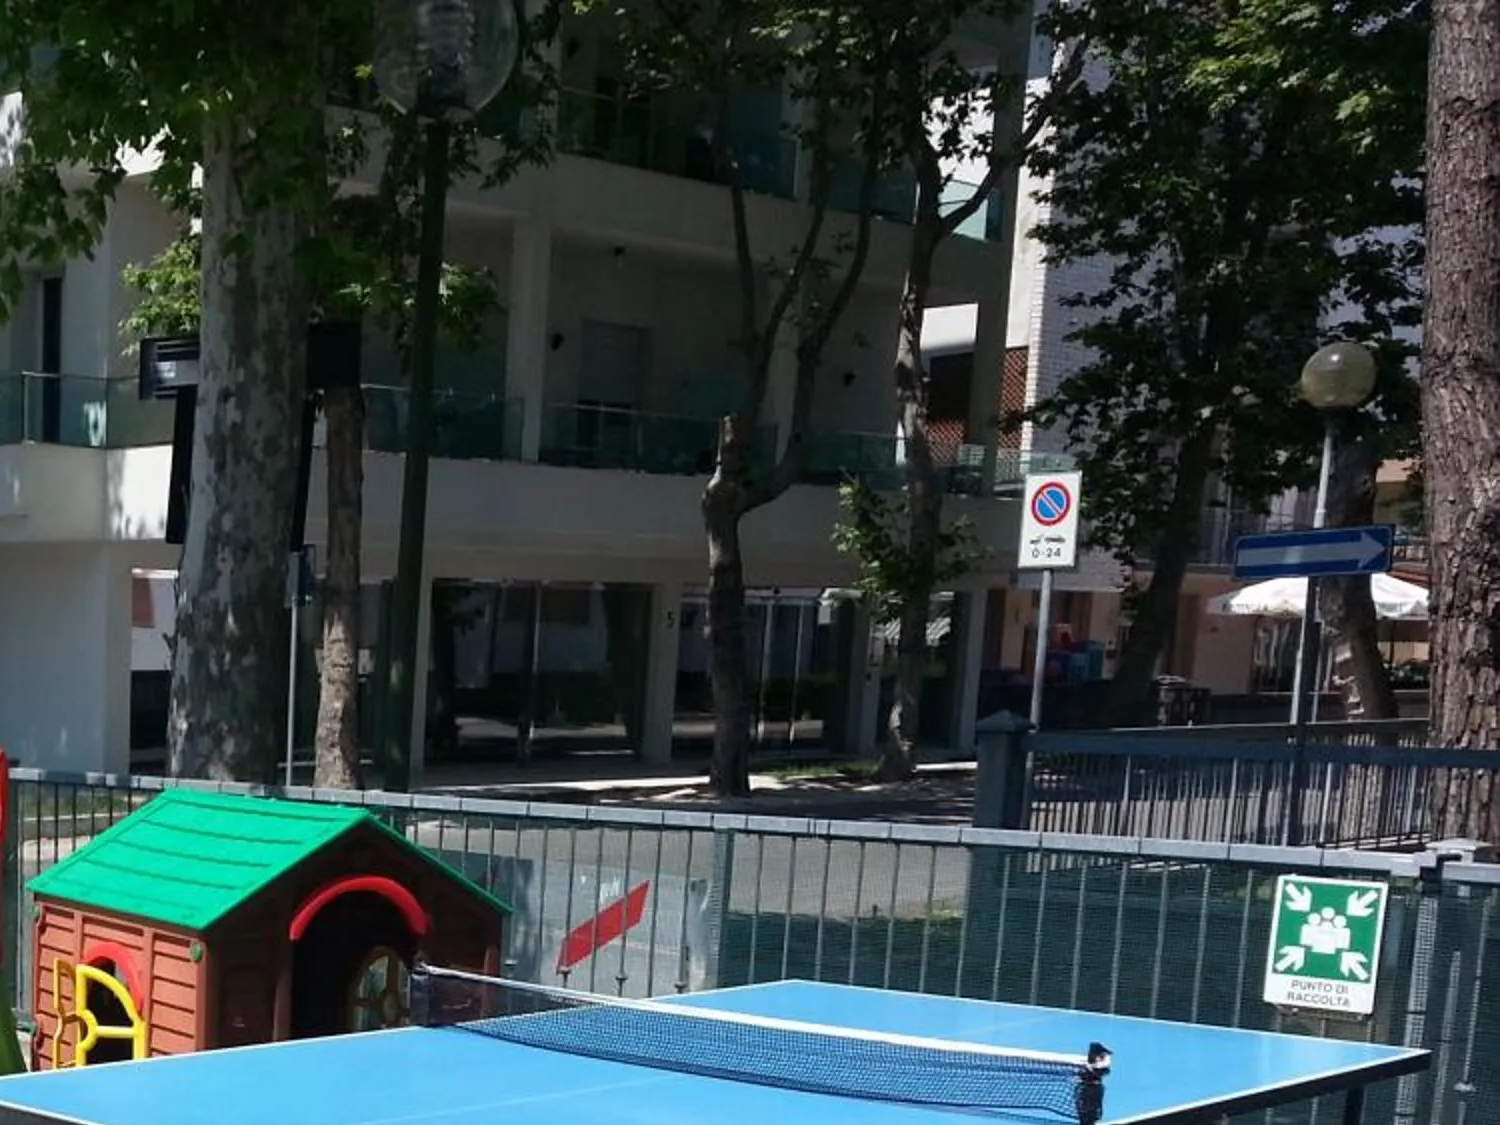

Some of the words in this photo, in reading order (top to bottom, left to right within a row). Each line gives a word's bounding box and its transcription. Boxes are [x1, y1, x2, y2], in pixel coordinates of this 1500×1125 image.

[1291, 979, 1333, 992] PUNTO
[1335, 984, 1349, 994] DI
[1287, 991, 1350, 1007] RACCOLTA
